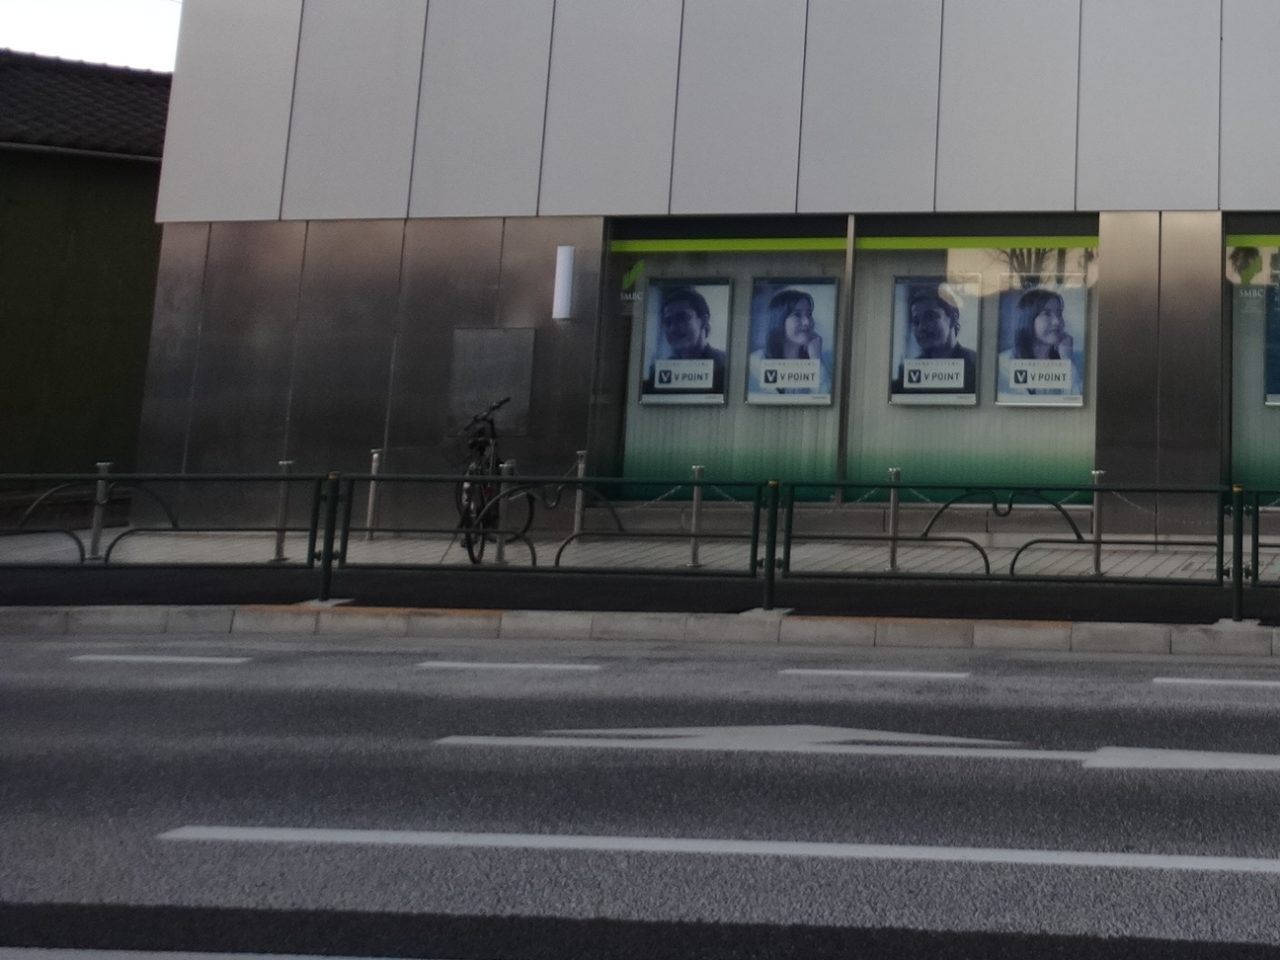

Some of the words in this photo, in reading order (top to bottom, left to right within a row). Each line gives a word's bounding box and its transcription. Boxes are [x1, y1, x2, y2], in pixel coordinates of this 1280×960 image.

[674, 372, 680, 381] V
[681, 372, 709, 381] POINT
[780, 372, 786, 381] V
[787, 372, 816, 382] POINT
[924, 372, 930, 381] V
[931, 372, 960, 381] POINT
[1030, 372, 1036, 381] V
[1038, 372, 1067, 382] POINT
